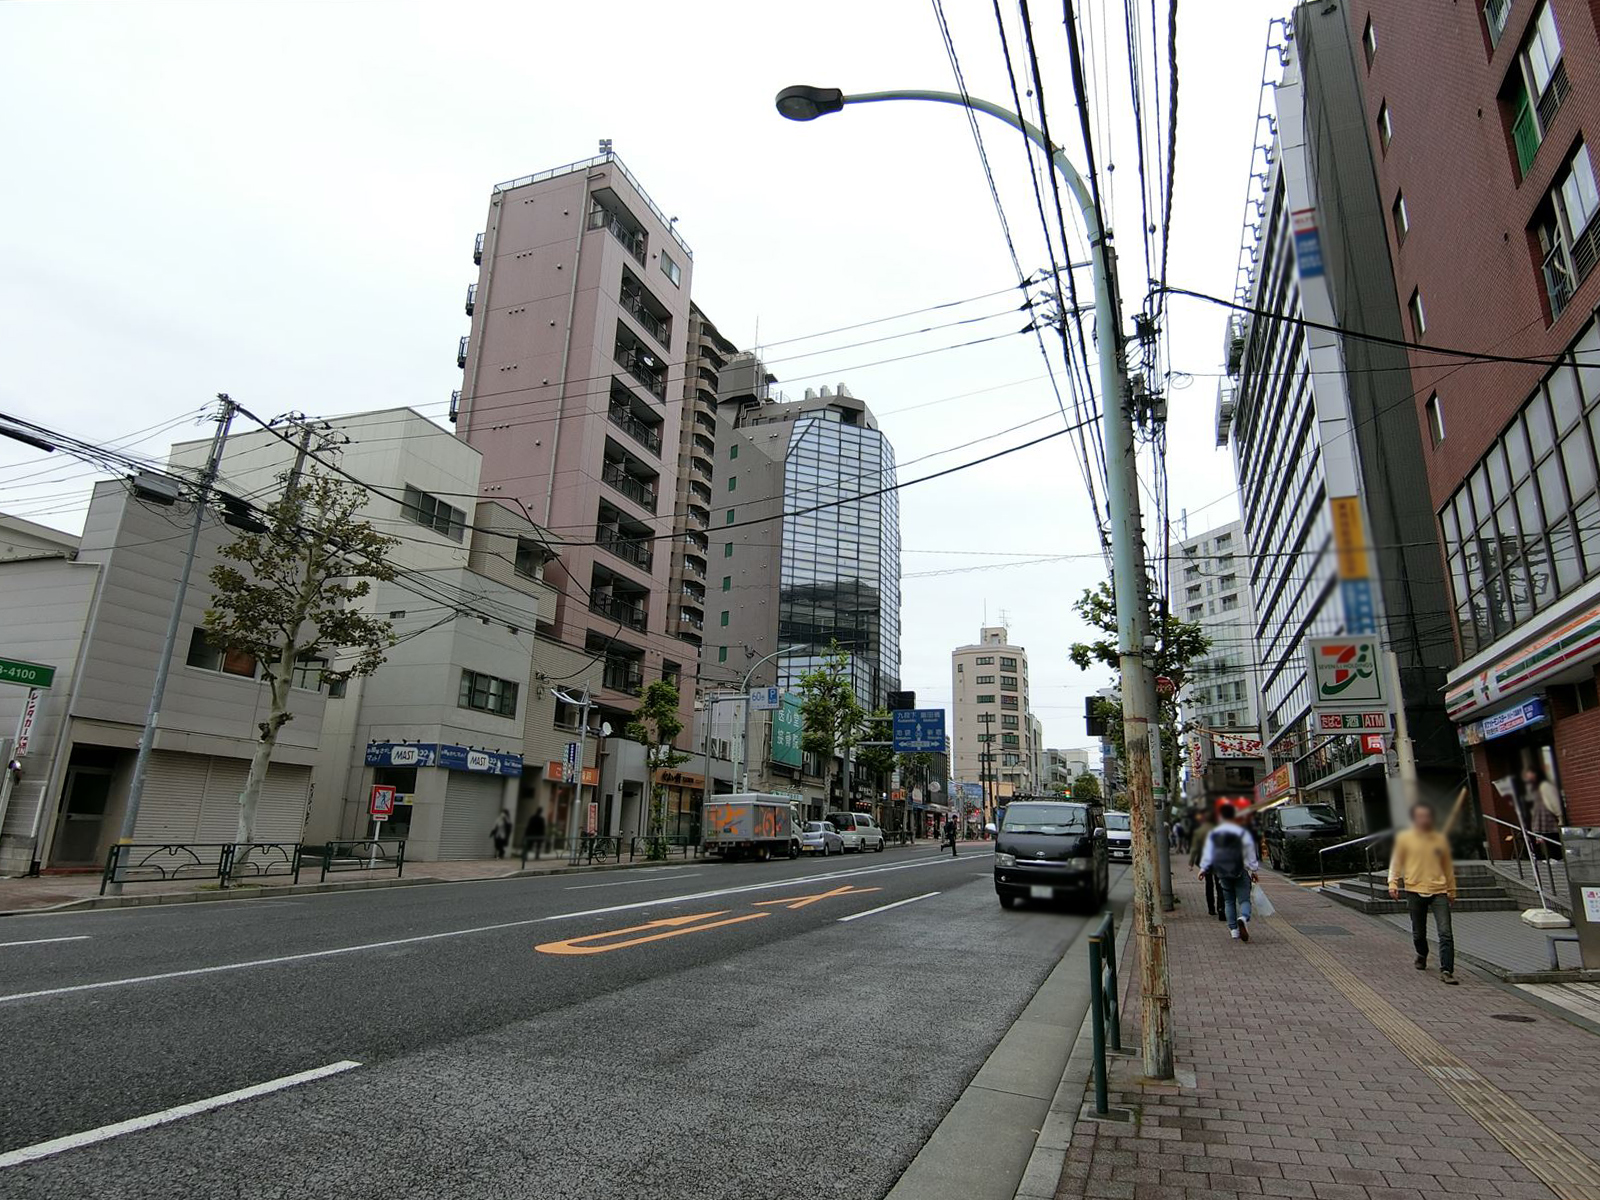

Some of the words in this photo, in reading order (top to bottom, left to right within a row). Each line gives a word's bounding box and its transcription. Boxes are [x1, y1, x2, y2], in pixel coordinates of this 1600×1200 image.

[1321, 716, 1342, 728] たばこ
[1345, 715, 1360, 727] 酒
[1365, 714, 1384, 727] ATM
[393, 750, 415, 761] MAST
[470, 756, 488, 767] MAST
[1193, 743, 1202, 770] ラーメン
